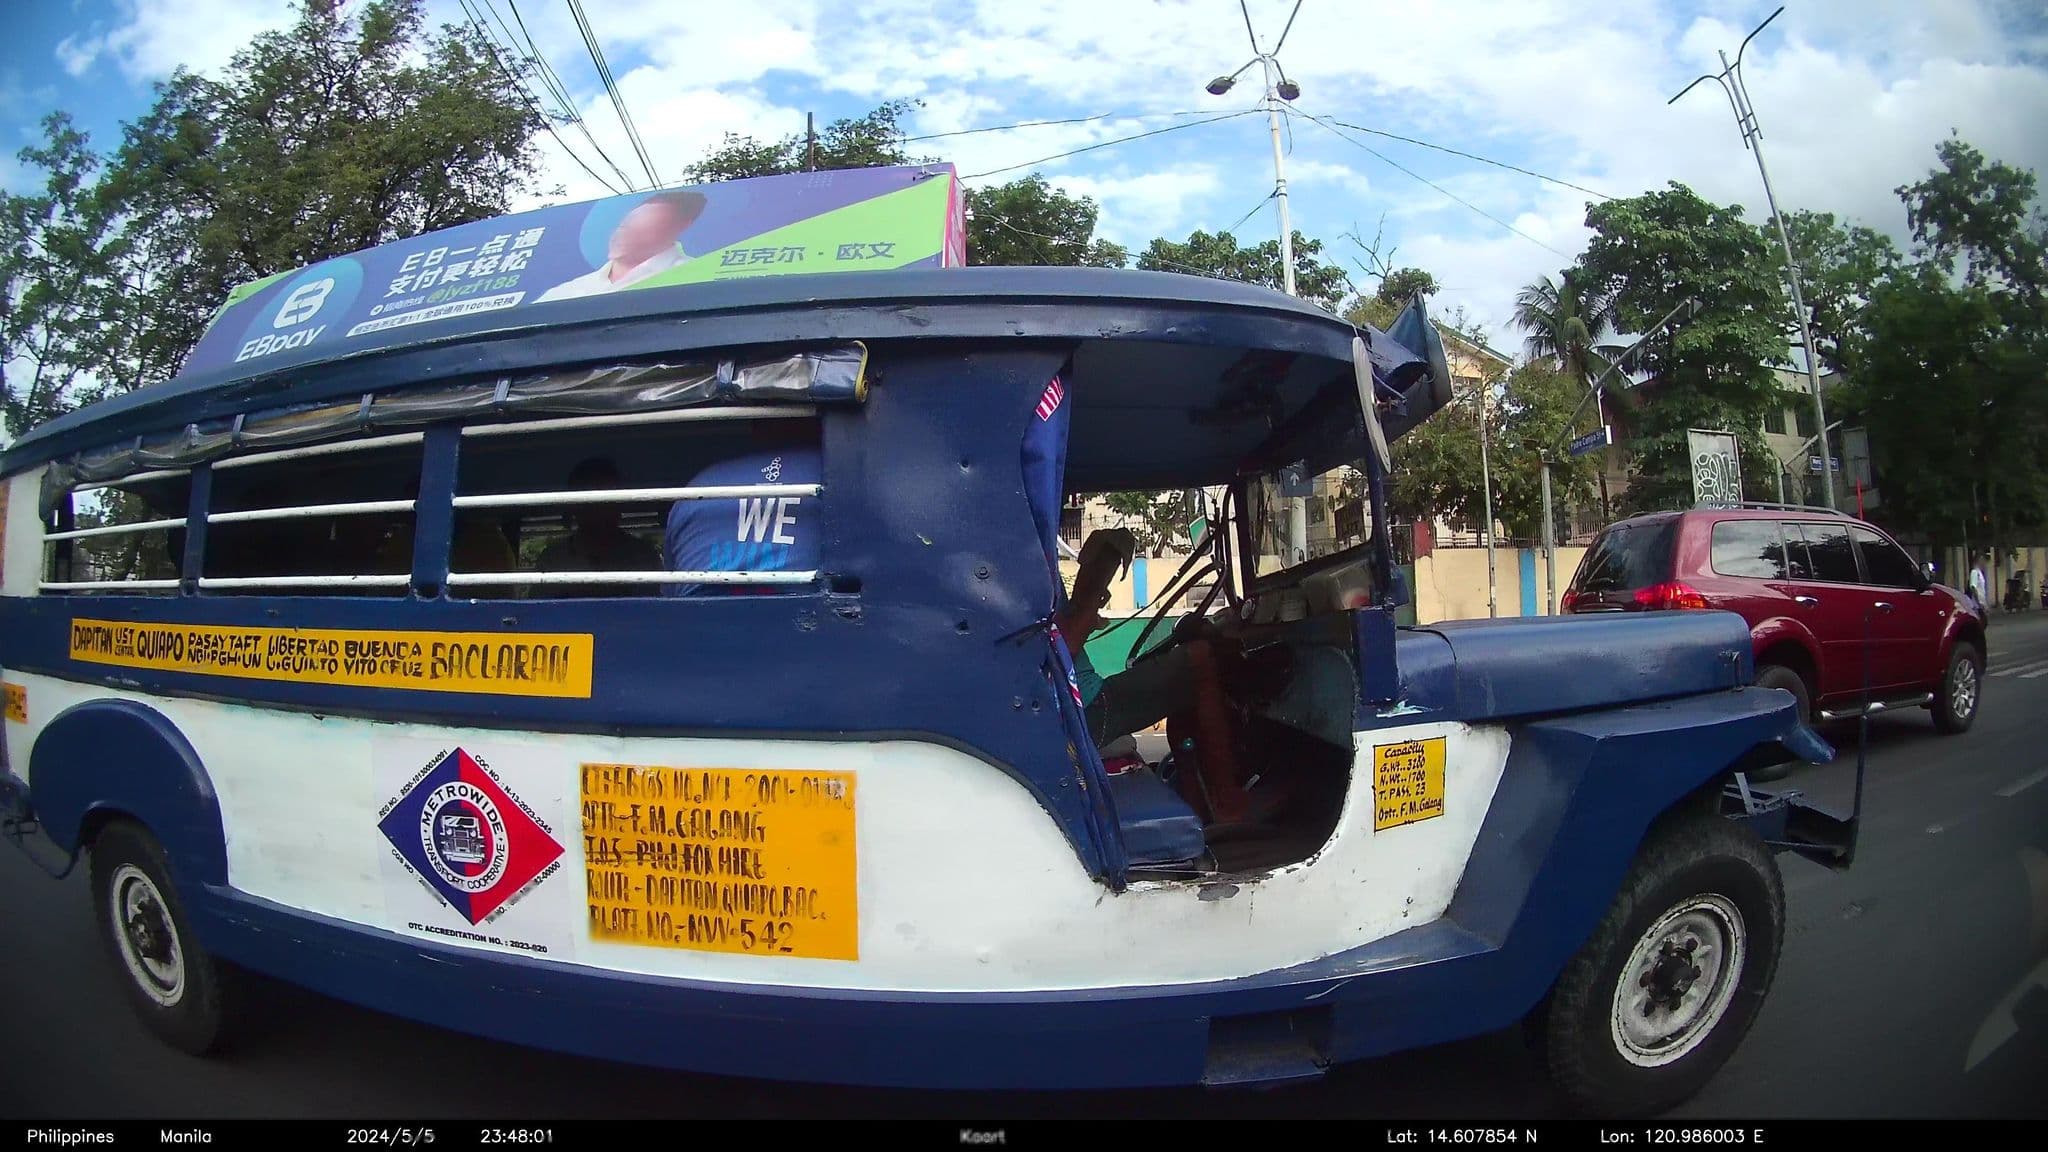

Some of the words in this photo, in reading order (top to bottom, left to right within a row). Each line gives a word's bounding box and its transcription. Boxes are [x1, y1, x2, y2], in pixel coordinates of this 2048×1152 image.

[383, 249, 533, 298] 支付更轻松
[235, 325, 327, 362] EBpay
[737, 497, 800, 545] WE
[73, 625, 113, 655] DAPITAN
[115, 627, 135, 645] UST
[137, 630, 184, 662] QUIAPO
[188, 632, 228, 650] PASAY
[229, 635, 262, 650] TAFT
[268, 635, 339, 658] LIBERTAD
[430, 642, 569, 684] BACLARAN
[344, 658, 377, 675] VITO
[475, 755, 489, 771] COC
[422, 785, 503, 834] METROWIDE
[1415, 781, 1426, 796] 23
[424, 838, 466, 887] TRANSPORT
[467, 843, 505, 889] COOPERATIVE
[408, 922, 424, 931] OTC
[425, 925, 487, 942] ACCREDITATION
